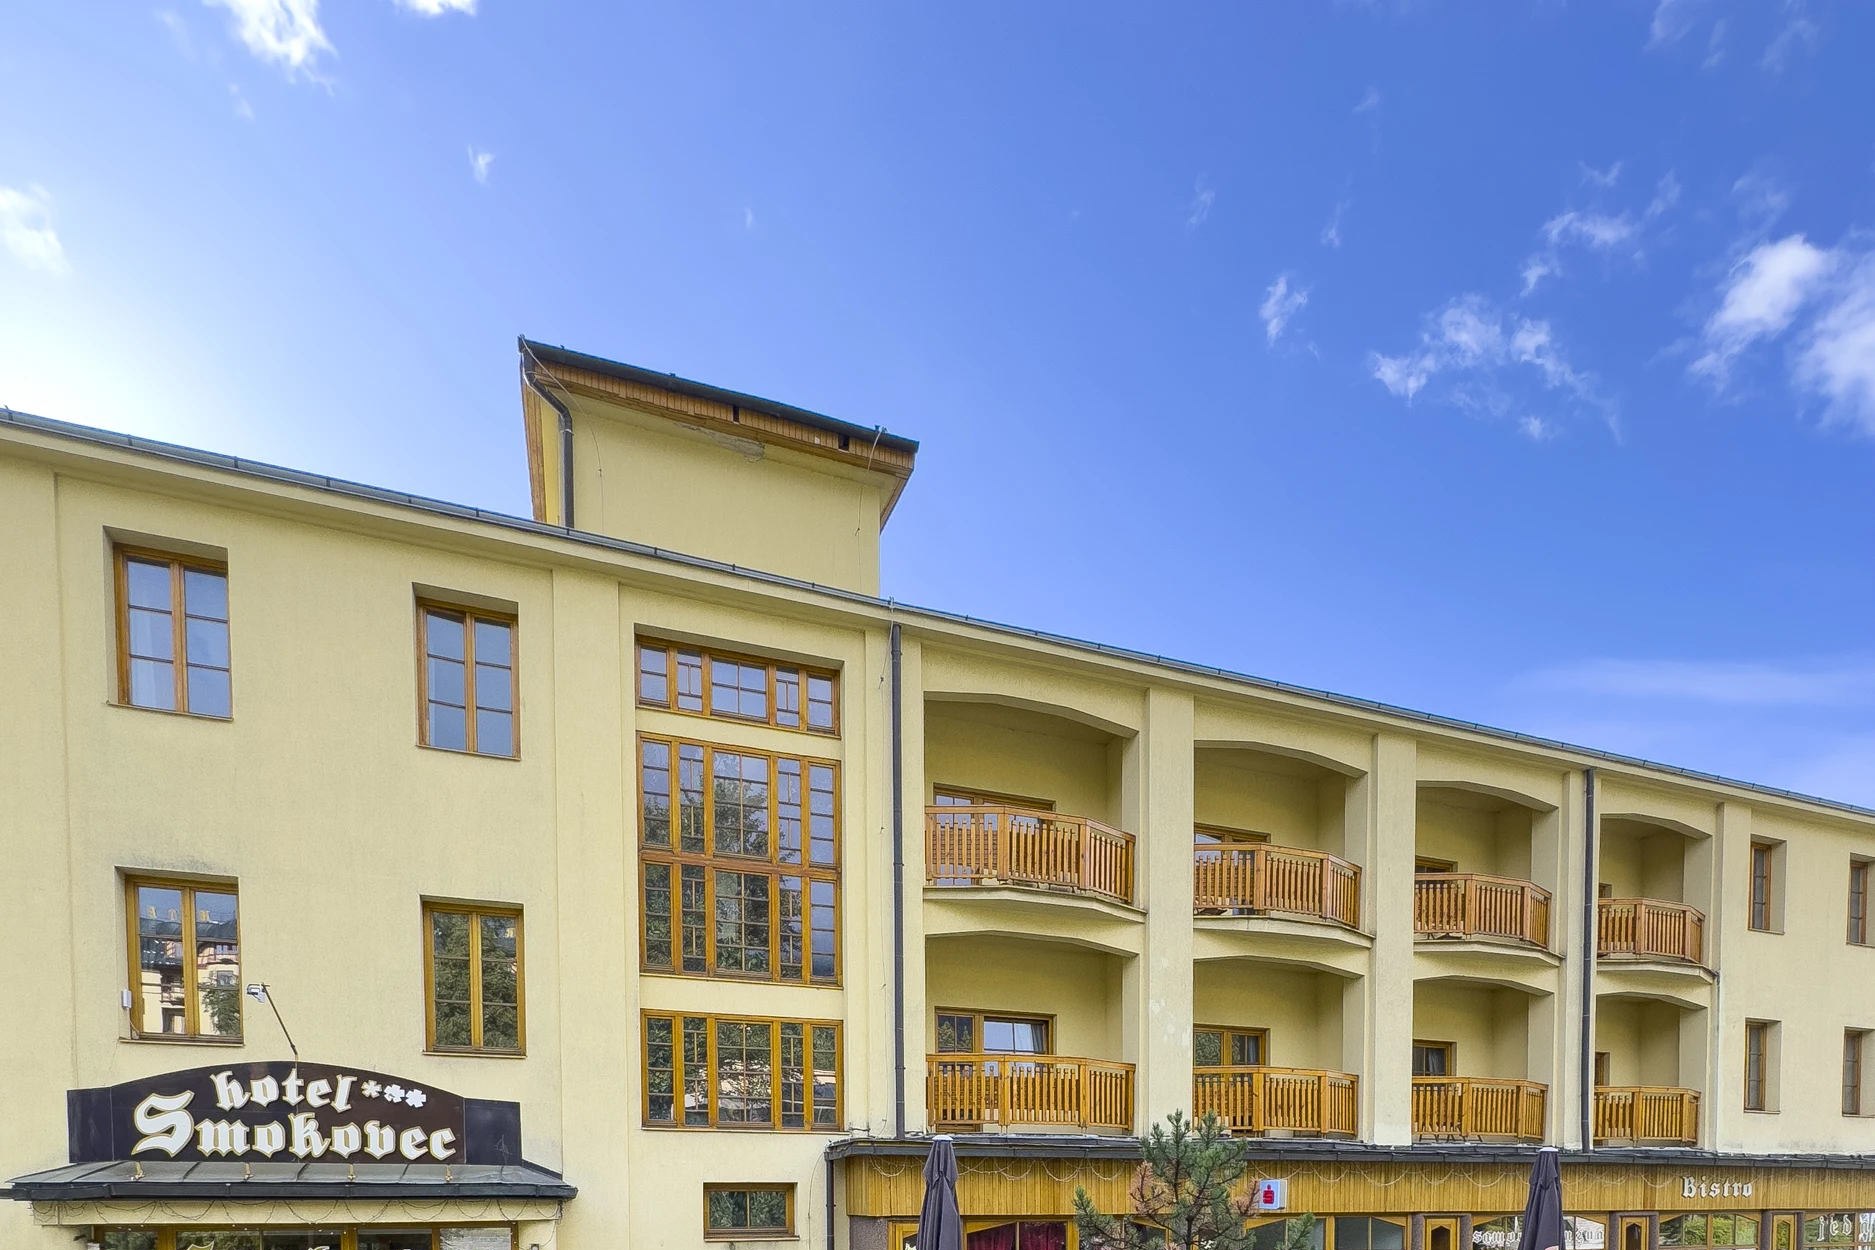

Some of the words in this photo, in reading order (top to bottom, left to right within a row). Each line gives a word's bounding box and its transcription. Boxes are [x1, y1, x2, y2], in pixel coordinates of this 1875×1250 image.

[210, 1068, 357, 1113] hotel
[131, 1090, 457, 1160] Smokovec
[1682, 1176, 1753, 1198] Bistro
